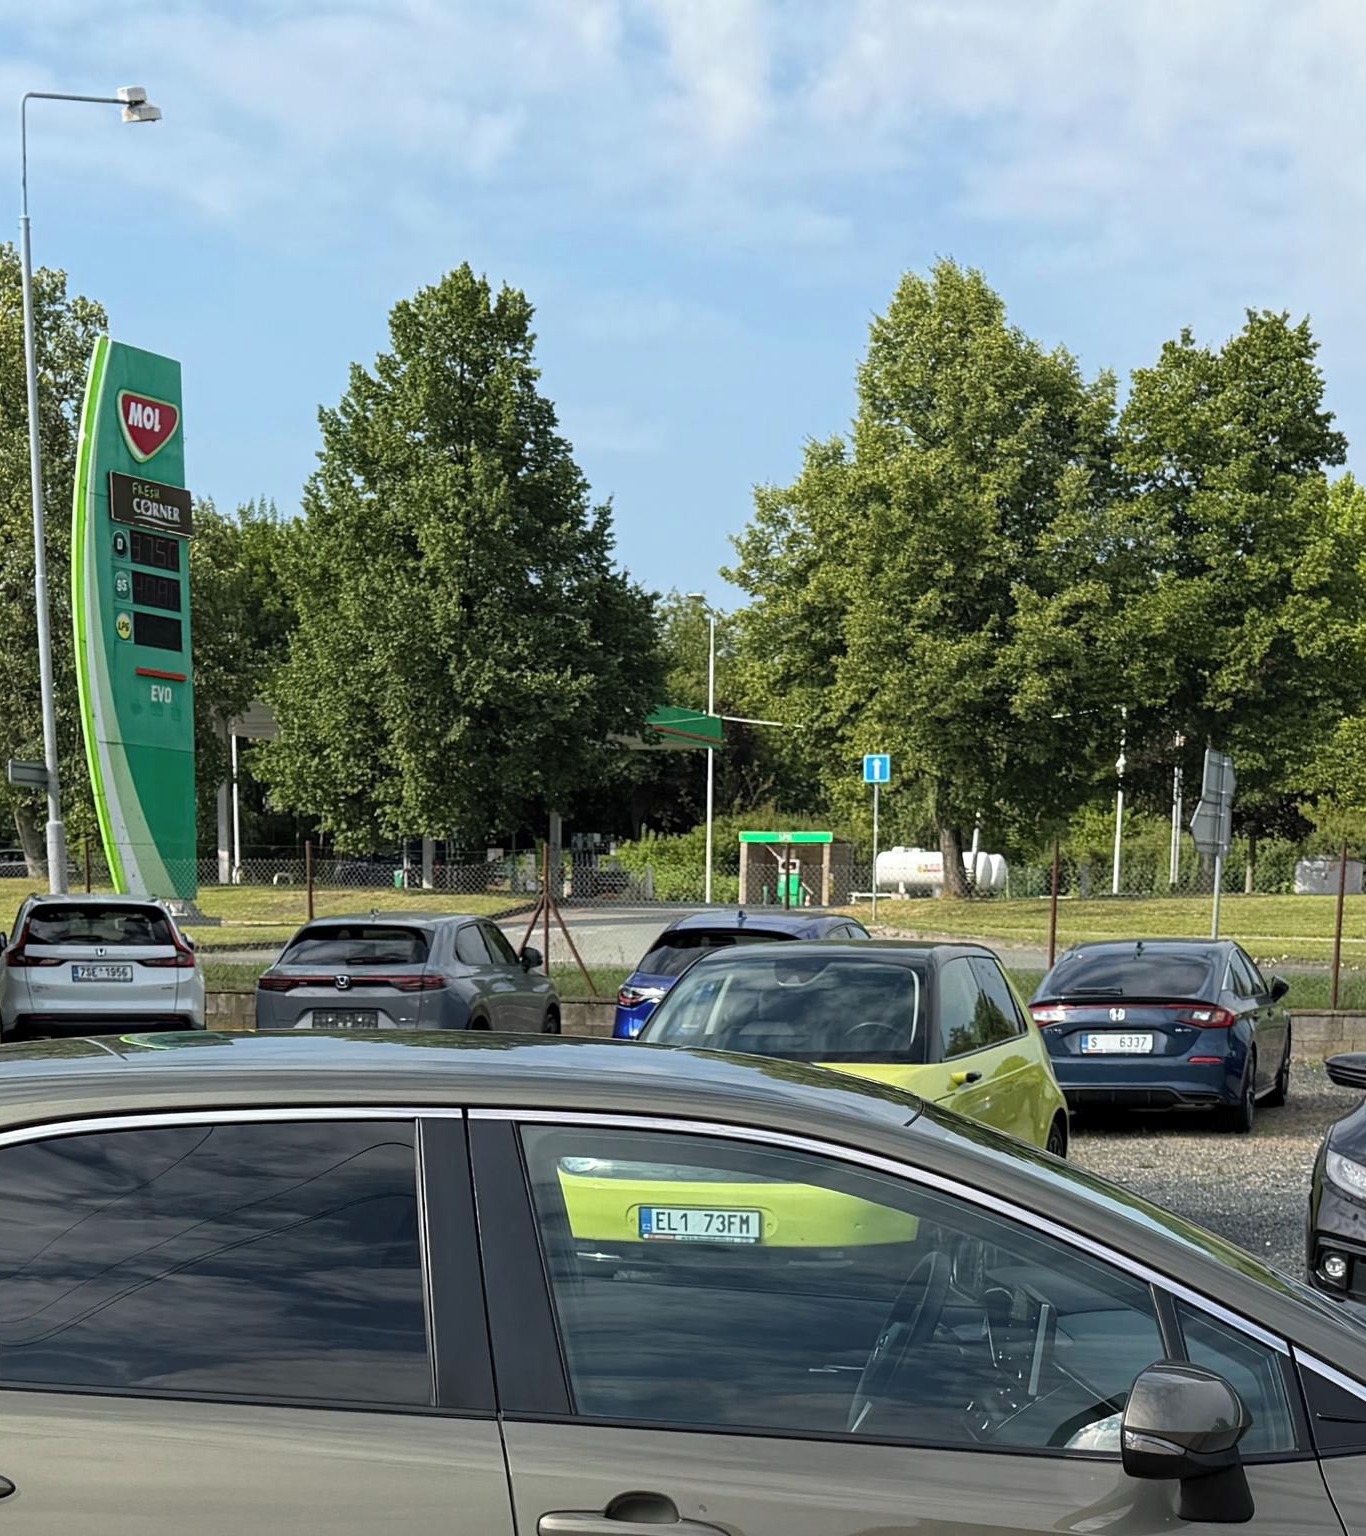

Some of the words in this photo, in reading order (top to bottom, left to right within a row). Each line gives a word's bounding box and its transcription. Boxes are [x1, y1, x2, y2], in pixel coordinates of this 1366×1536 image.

[128, 401, 161, 433] MOL
[133, 499, 180, 522] CORNER
[116, 579, 128, 592] 95
[118, 620, 130, 633] LPG
[151, 684, 172, 704] EVO
[1091, 1036, 1098, 1048] S
[1119, 1037, 1147, 1048] 6337
[656, 1212, 688, 1231] EL1
[704, 1214, 749, 1234] 73FM
